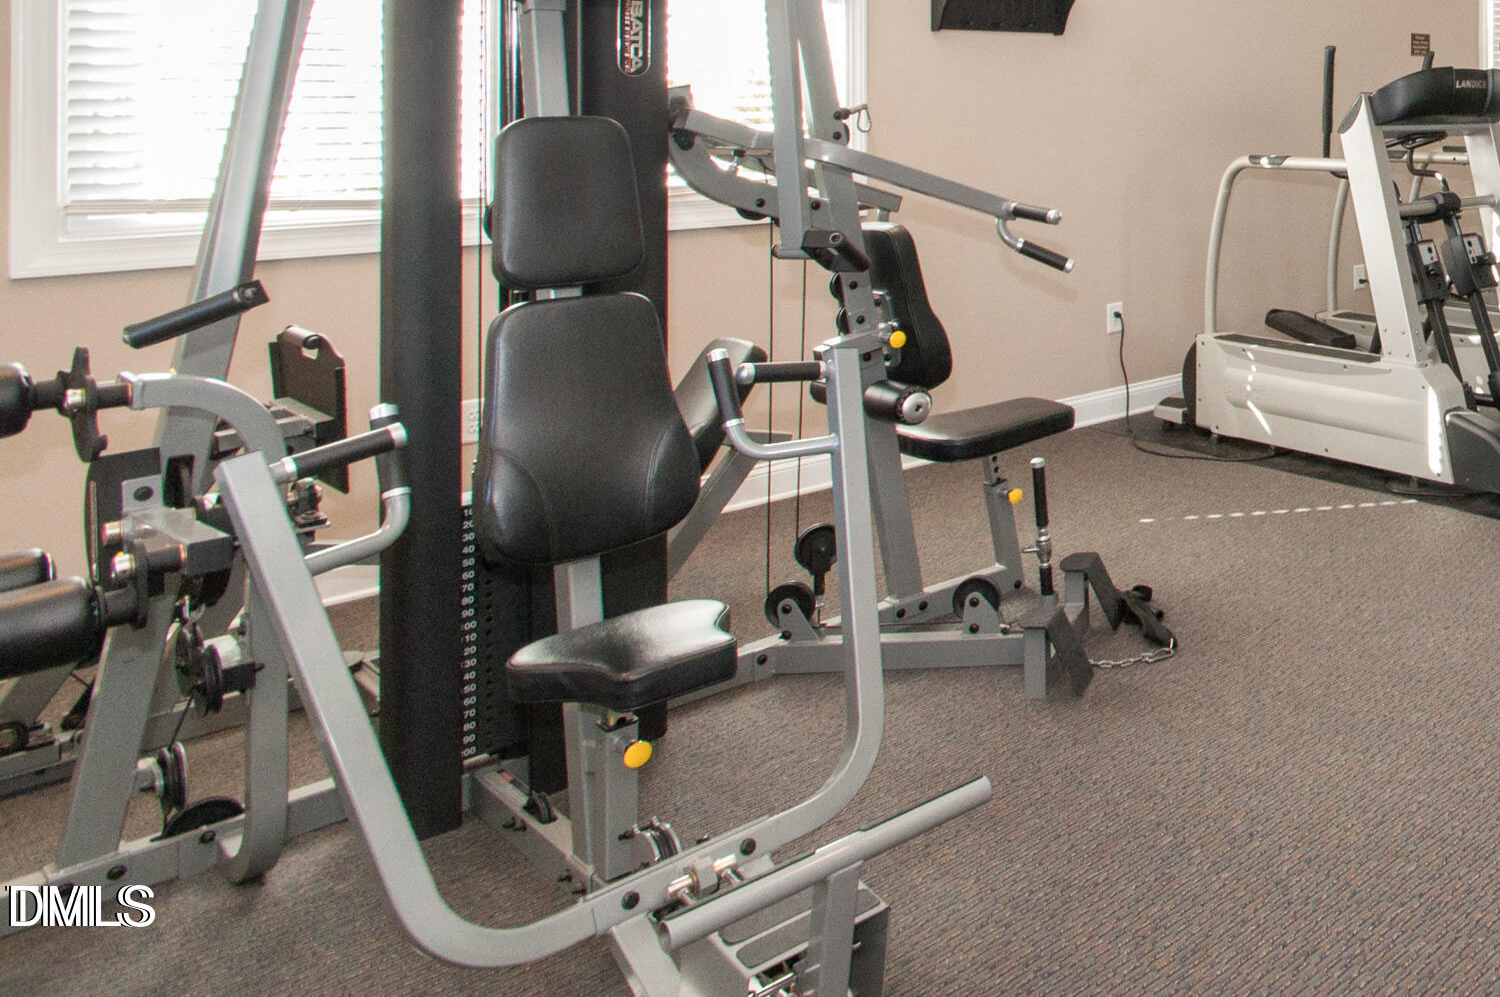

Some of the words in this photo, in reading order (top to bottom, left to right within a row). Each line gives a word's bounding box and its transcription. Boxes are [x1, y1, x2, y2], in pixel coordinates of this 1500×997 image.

[631, 0, 645, 74] BATCA
[461, 532, 476, 542] 30
[461, 544, 476, 554] 40
[461, 557, 476, 568] 50
[461, 570, 476, 581] 60
[461, 582, 475, 593] 70
[461, 595, 475, 606] 80
[461, 608, 475, 619] 90
[463, 645, 477, 657] 20
[461, 658, 478, 669] 30
[463, 670, 477, 680] 40
[463, 683, 477, 694] 50
[463, 695, 477, 707] 60
[463, 708, 477, 719] 70
[462, 721, 477, 732] 80
[462, 733, 476, 745] 90
